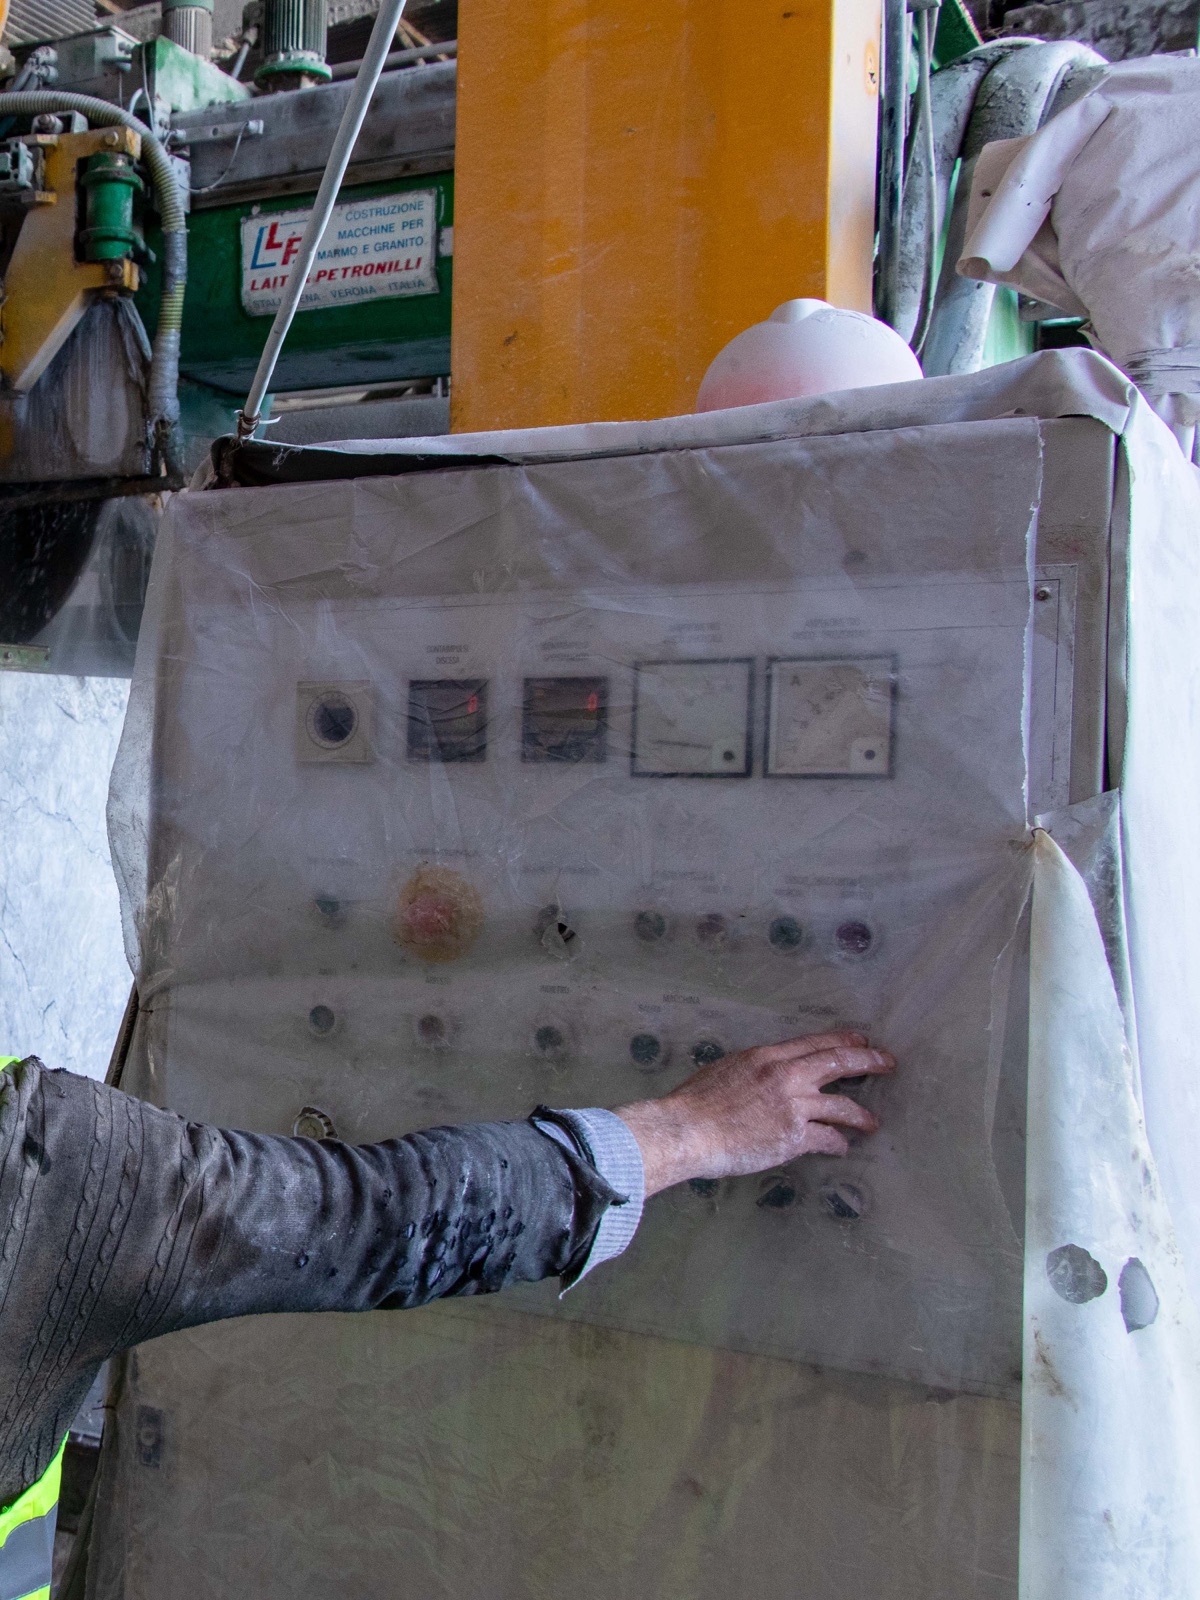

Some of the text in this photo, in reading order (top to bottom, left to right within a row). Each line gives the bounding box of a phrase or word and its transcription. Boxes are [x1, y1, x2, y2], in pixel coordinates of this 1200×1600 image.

[345, 200, 424, 222] COSTRUZIONE
[337, 218, 424, 240] MACCHINE PER
[317, 236, 424, 260] MARMO E GRANITO
[315, 256, 422, 283] PETRONILLI
[330, 286, 377, 299] VERONA
[388, 279, 425, 292] ITALIA
